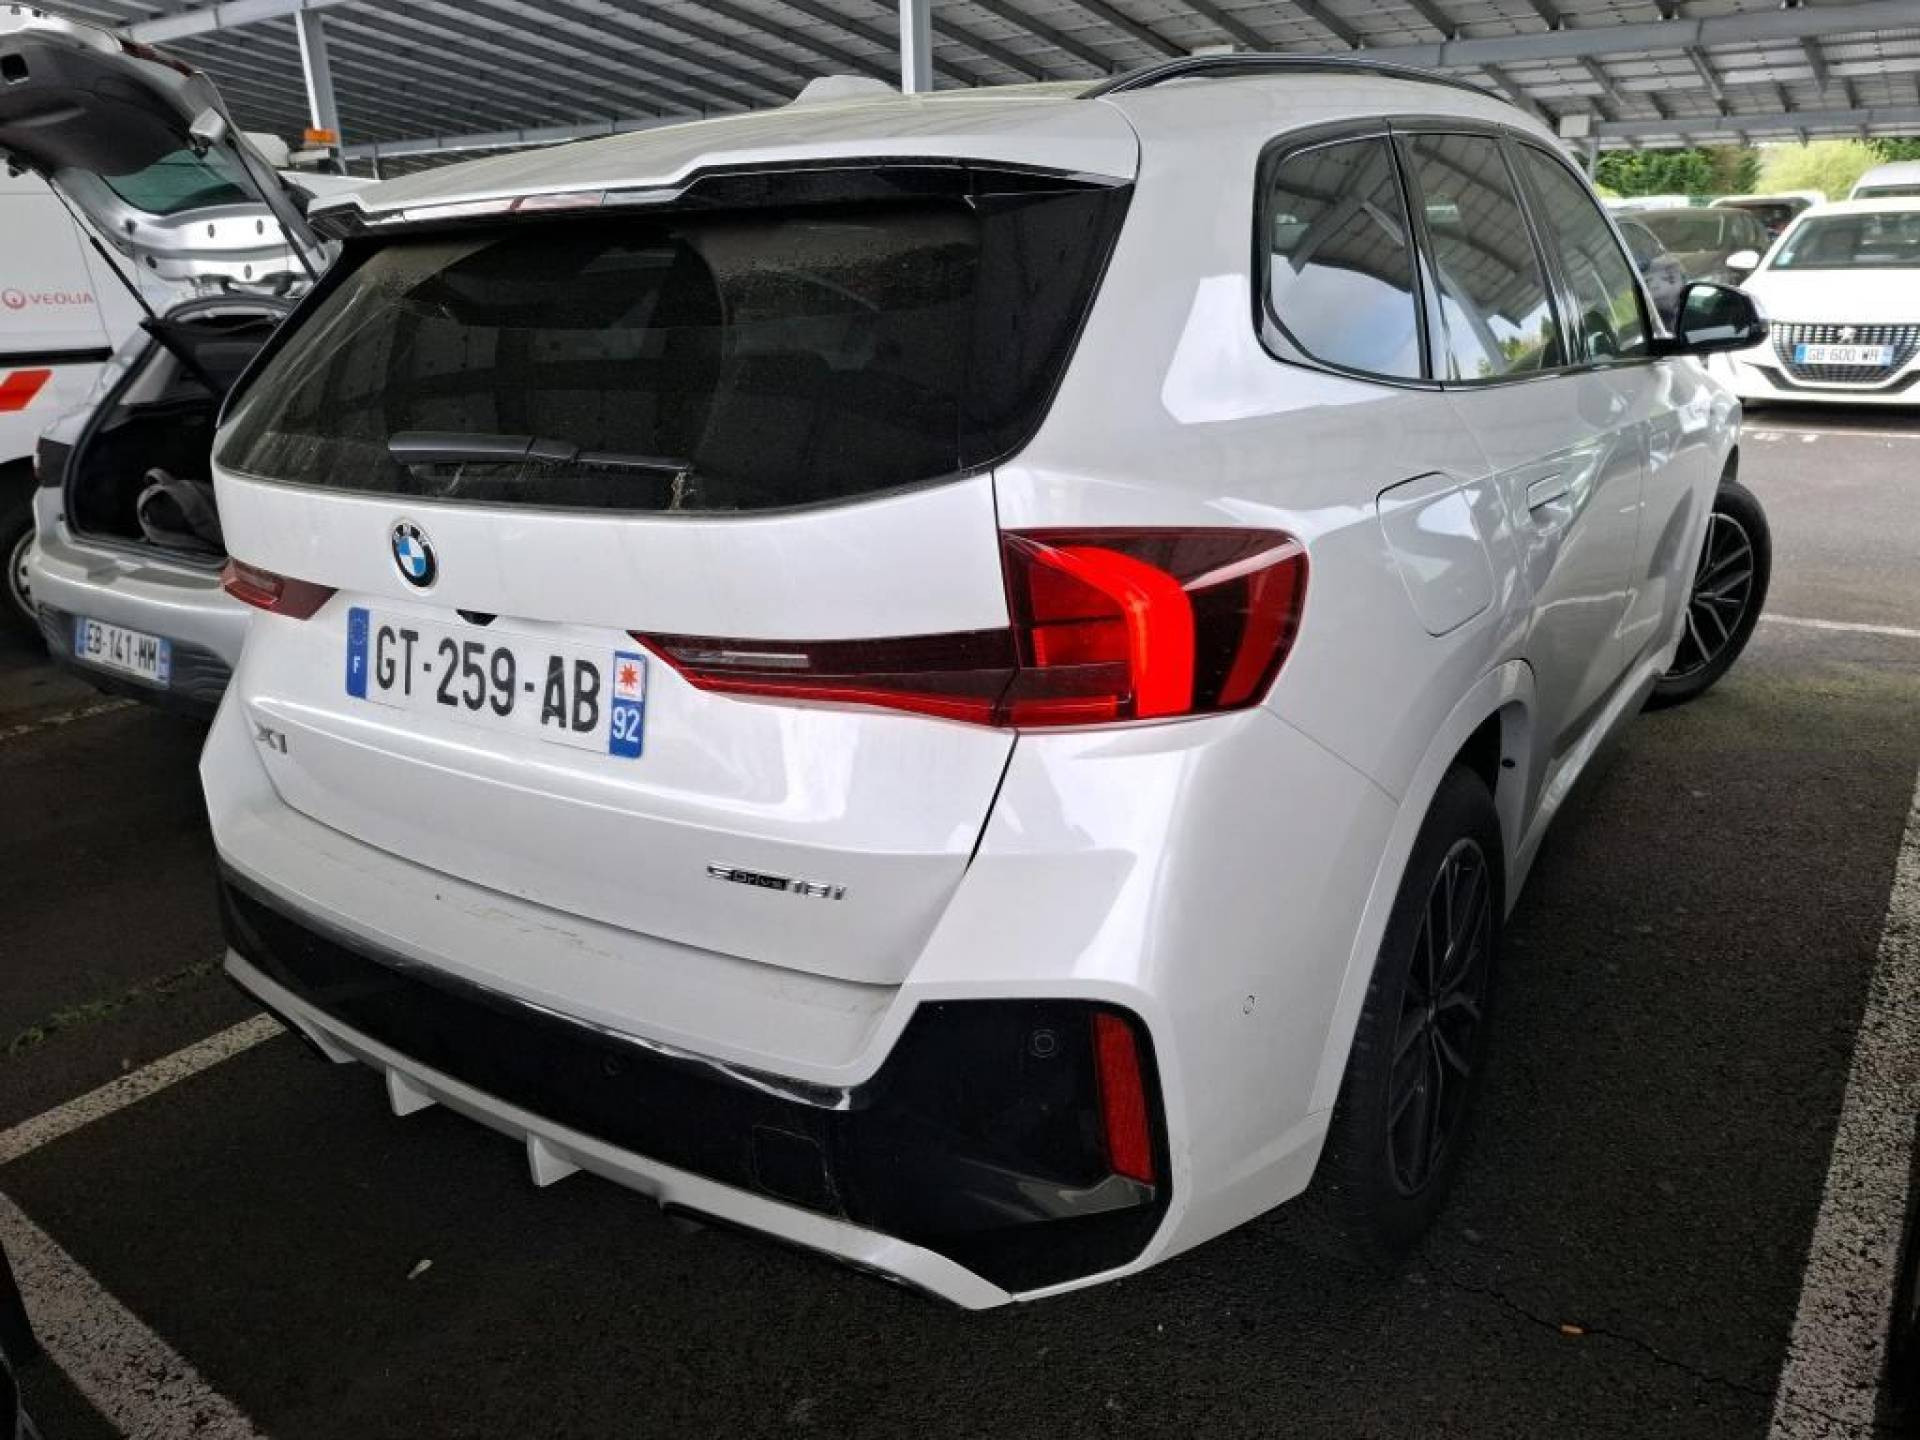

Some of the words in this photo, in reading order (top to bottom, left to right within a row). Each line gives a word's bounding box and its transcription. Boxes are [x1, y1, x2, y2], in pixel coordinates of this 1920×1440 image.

[28, 292, 94, 305] VEOLIA
[353, 655, 361, 674] F
[376, 625, 600, 734] GT-259-AB
[612, 705, 641, 743] 92
